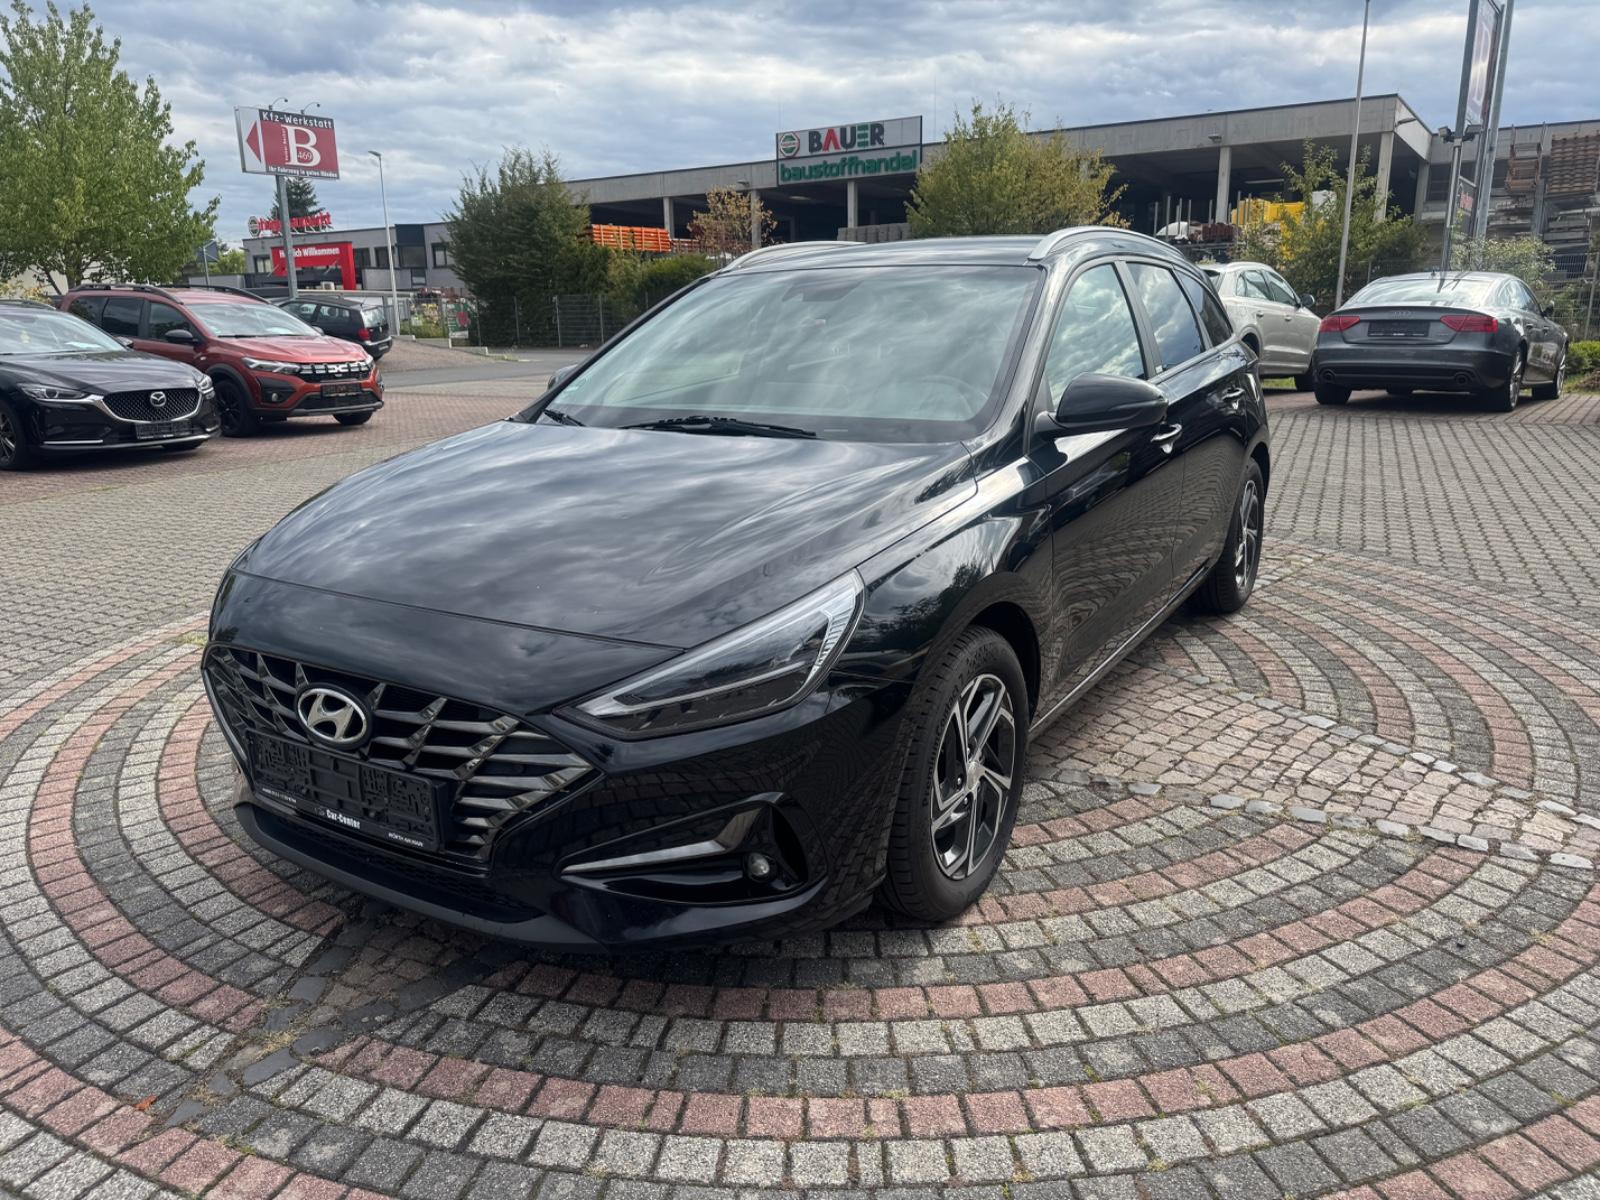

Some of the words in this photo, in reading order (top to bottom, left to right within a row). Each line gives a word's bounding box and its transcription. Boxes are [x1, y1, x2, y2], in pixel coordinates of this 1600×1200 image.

[262, 112, 332, 129] Kfz-Werkstatt
[281, 124, 321, 167] B
[809, 123, 885, 153] BAUER
[780, 150, 917, 182] baustoffhandel
[303, 247, 340, 257] Willkommen
[326, 809, 361, 830] Car-Center
